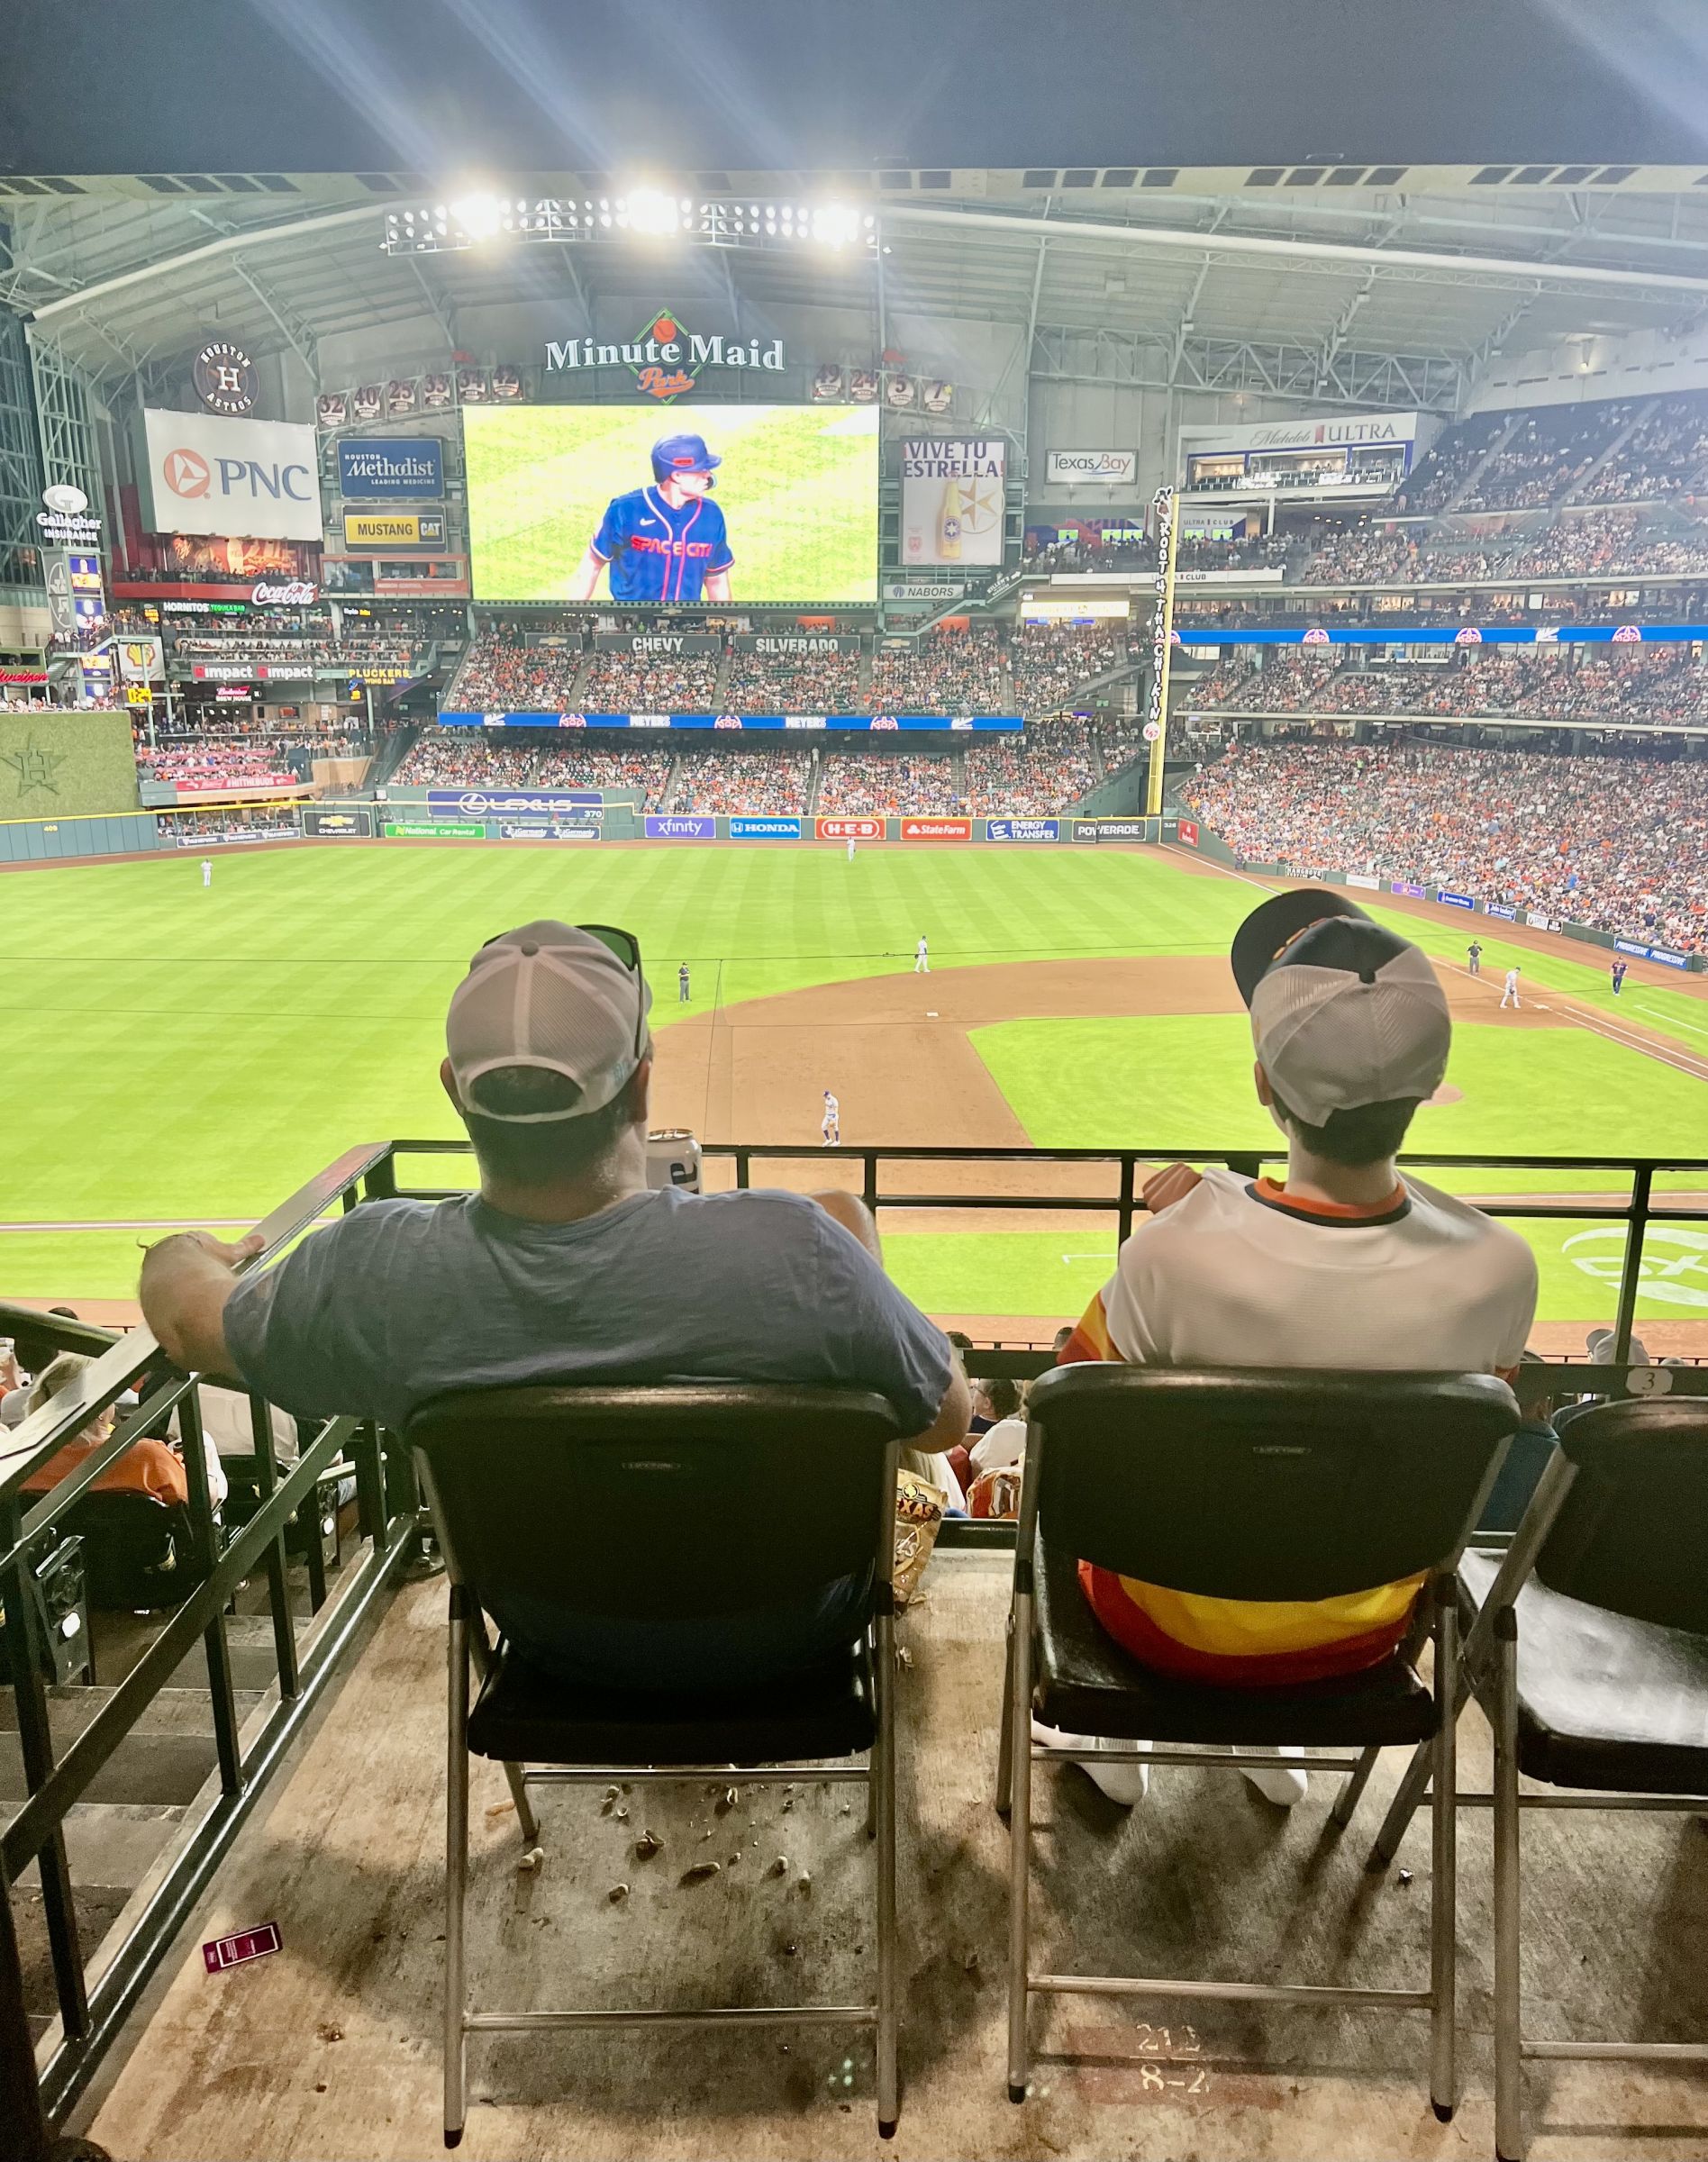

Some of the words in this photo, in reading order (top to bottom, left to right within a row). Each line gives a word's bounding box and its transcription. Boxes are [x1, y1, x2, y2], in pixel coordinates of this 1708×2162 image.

[200, 343, 251, 368] HOUSTON
[545, 337, 680, 371] Minute
[688, 334, 785, 371] Maid
[216, 366, 241, 392] H
[637, 367, 694, 394] Park
[206, 392, 251, 413] ASTROS
[1249, 430, 1312, 447] Michelob
[1328, 423, 1395, 441] ULTRA
[961, 441, 987, 459] TU
[346, 458, 434, 477] Methodist
[1052, 453, 1095, 469] Texas
[1101, 453, 1131, 475] Bay
[214, 458, 313, 501] PNC
[36, 513, 102, 531] Gallagher
[358, 523, 413, 536] MUSTANG
[420, 522, 441, 537] CAT
[44, 528, 98, 541] INSURANCE
[631, 535, 683, 557] SPACE
[251, 581, 317, 605] Coca-Cola
[907, 587, 954, 596] NABORS
[163, 602, 209, 613] HORNITOS
[210, 604, 233, 613] TEQUILA
[631, 637, 684, 652] CHEVY
[756, 638, 839, 652] SILVERADO
[204, 664, 253, 680] impact
[268, 665, 313, 680] impact
[349, 668, 410, 677] PLUCKERS
[630, 716, 671, 727] MEYERS
[786, 717, 827, 728] MEYERS
[490, 798, 572, 812] LEXUS
[584, 810, 602, 818] 370
[405, 827, 436, 835] National
[658, 819, 703, 836] xfinity
[744, 823, 800, 832] HONDA
[1012, 821, 1045, 830] ENERGY
[1077, 824, 1140, 837] POWERADE
[1012, 830, 1055, 840] TRANSFER
[1642, 1372, 1655, 1390] 3
